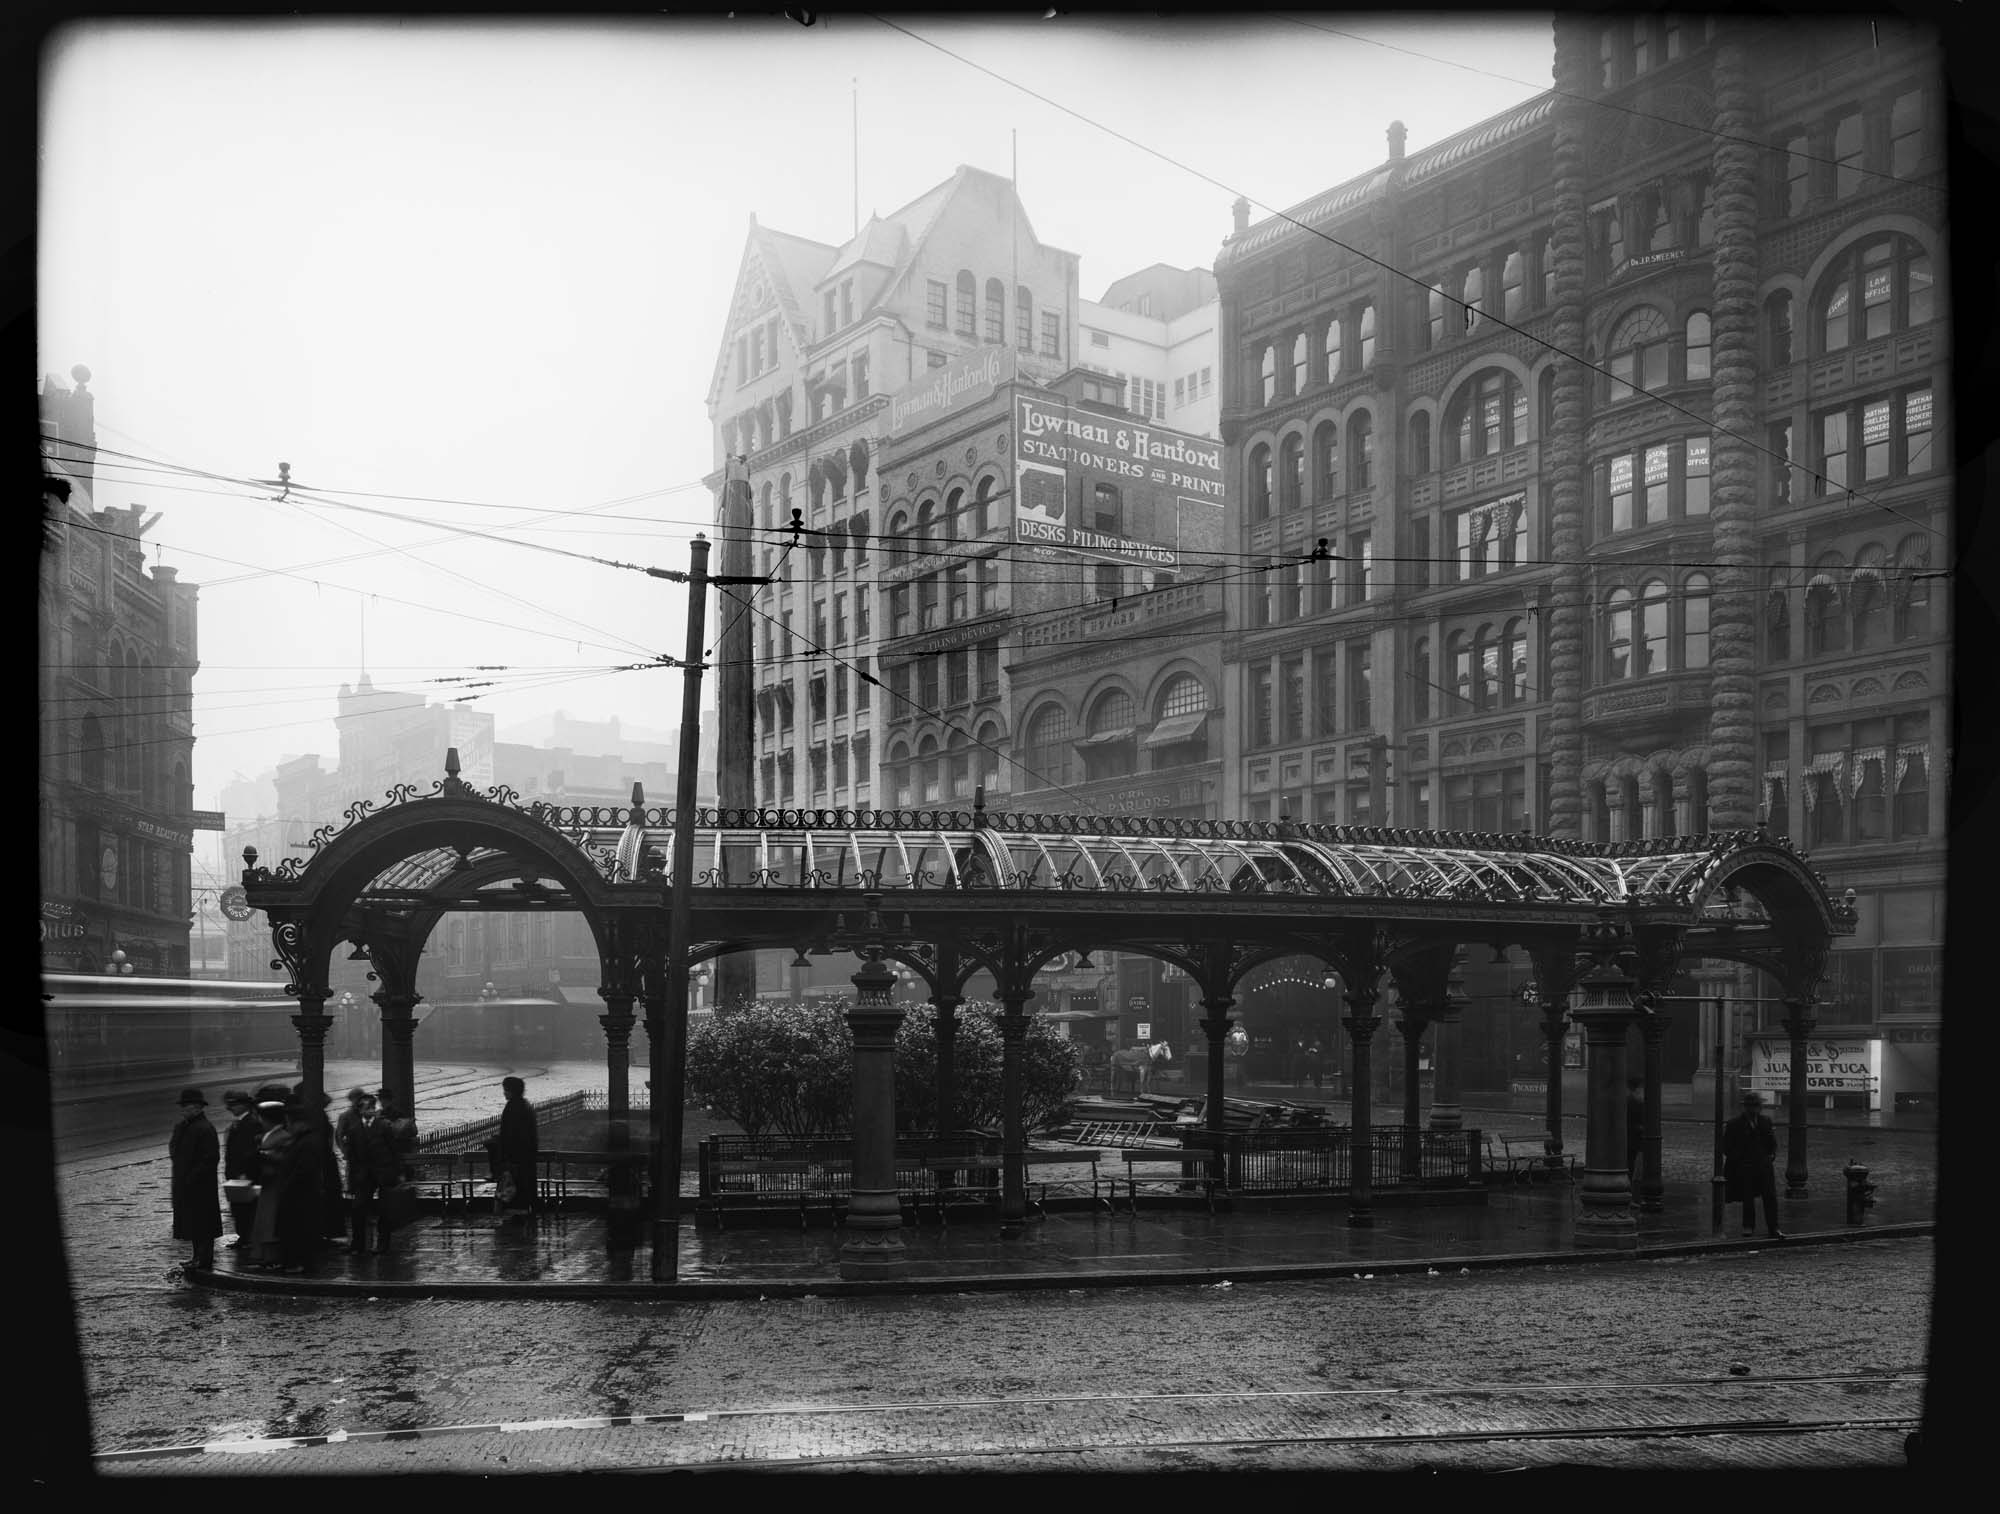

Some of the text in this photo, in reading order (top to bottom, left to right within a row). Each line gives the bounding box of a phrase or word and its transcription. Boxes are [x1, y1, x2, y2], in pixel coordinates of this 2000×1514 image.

[1869, 275, 1886, 288] LAW
[1022, 403, 1221, 471] Lowman & Hanford
[1690, 447, 1706, 456] LAW
[1023, 439, 1145, 478] STATIONERS
[1151, 470, 1167, 481] AND
[1687, 457, 1709, 467] OFFICE
[1072, 528, 1117, 553] FILING
[1120, 540, 1175, 564] DEVICES
[928, 622, 1001, 650] FILING DEVICES
[1110, 790, 1144, 801] YORK
[1108, 794, 1170, 812] PARLORS
[136, 820, 154, 835] STAR
[1808, 1043, 1820, 1057] &
[1764, 1063, 1791, 1073] JUA
[1830, 1063, 1869, 1074] FUCA
[1808, 1078, 1844, 1087] GARS
